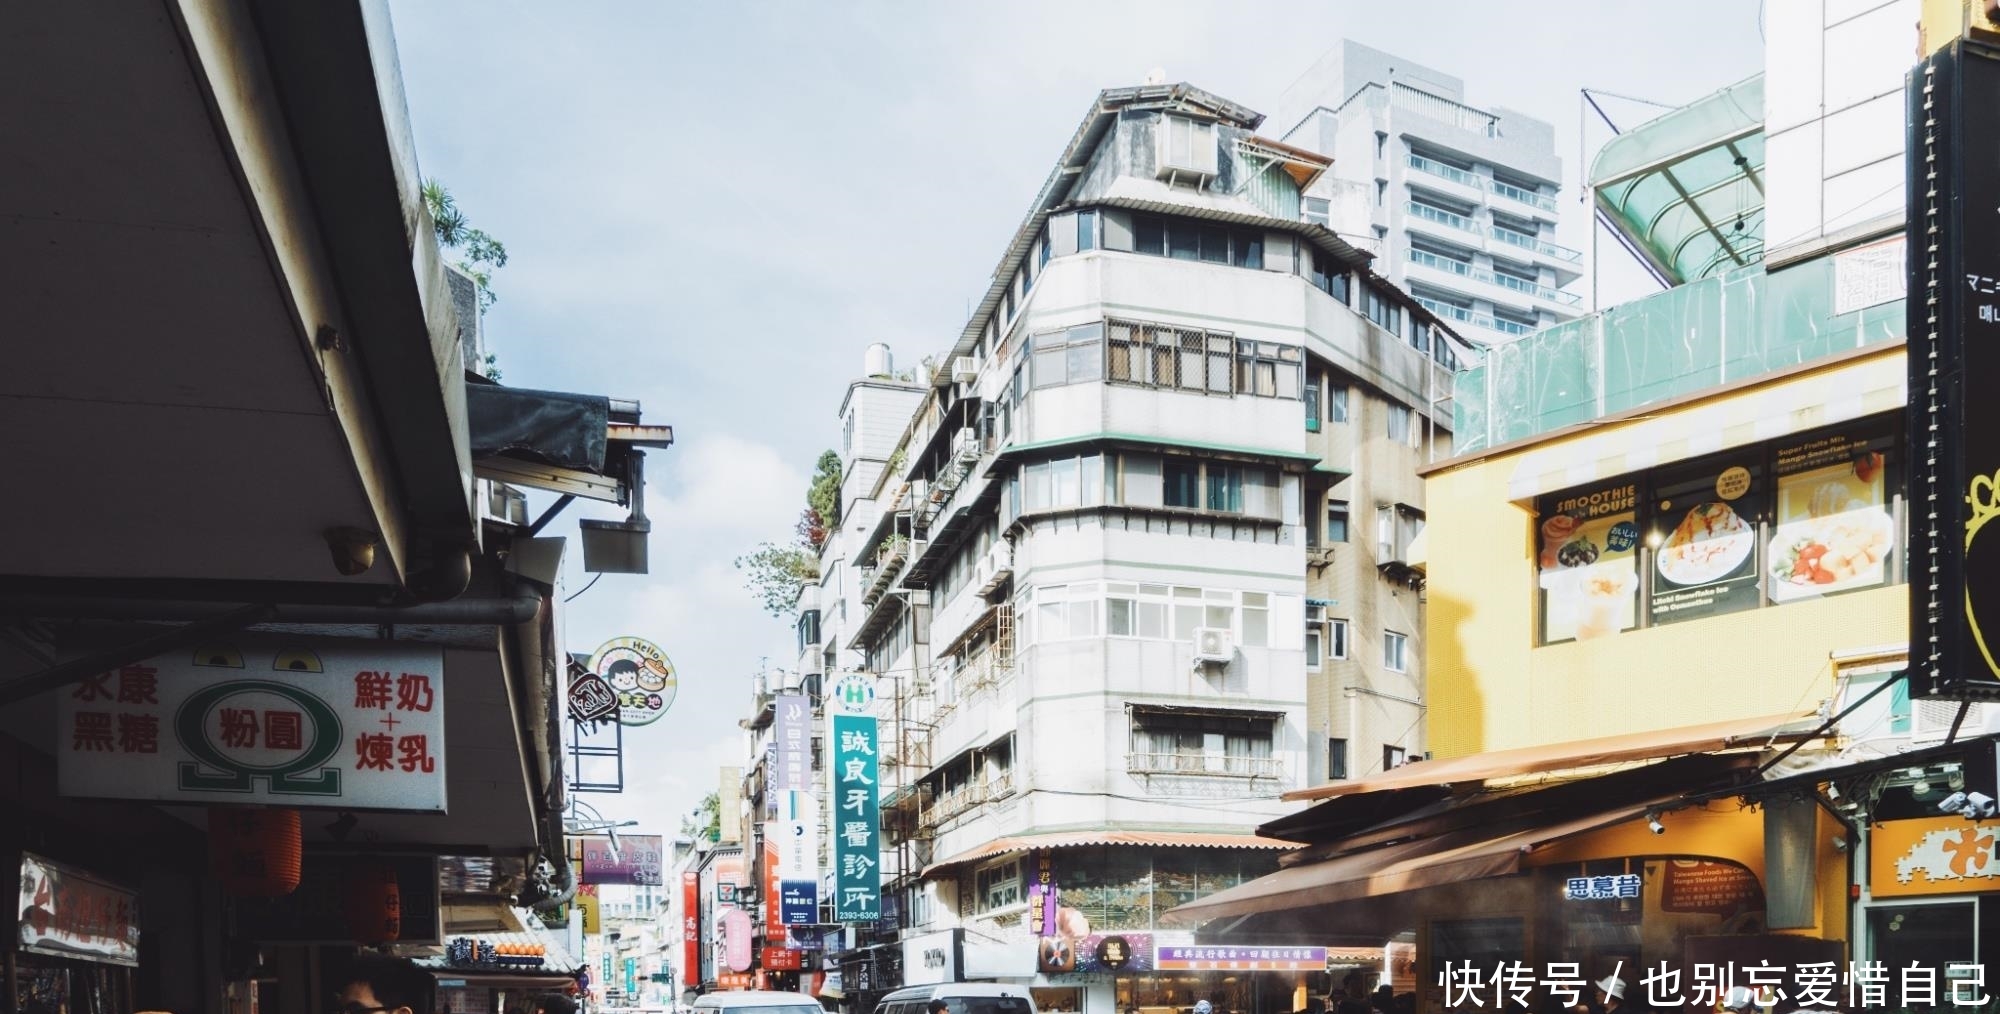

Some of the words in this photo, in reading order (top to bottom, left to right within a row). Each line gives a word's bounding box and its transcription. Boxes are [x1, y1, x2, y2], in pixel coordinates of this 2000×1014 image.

[1966, 273, 2000, 294] マニ
[1778, 446, 1802, 456] Super
[1804, 440, 1828, 450] Fruits
[1830, 436, 1845, 444] Mix
[1777, 454, 1806, 465] Mango
[1556, 485, 1635, 513] SMOOTHIE
[1589, 497, 1635, 517] HOUSE
[1611, 527, 1638, 538] おいしい
[1675, 589, 1715, 602] Snowflake
[1716, 586, 1729, 594] Ice
[1652, 605, 1669, 614] with
[633, 641, 660, 660] Hello
[354, 671, 434, 712] 鮮奶
[73, 711, 160, 754] 黑糖
[219, 709, 303, 751] 粉圓
[355, 732, 435, 773] 煉乳
[840, 730, 876, 911] 誠良牙醫診所
[1674, 870, 1704, 878] Taiwanese
[1704, 868, 1722, 876] Foods
[1566, 875, 1641, 899] 思慕昔
[838, 911, 879, 921] 2393-6306
